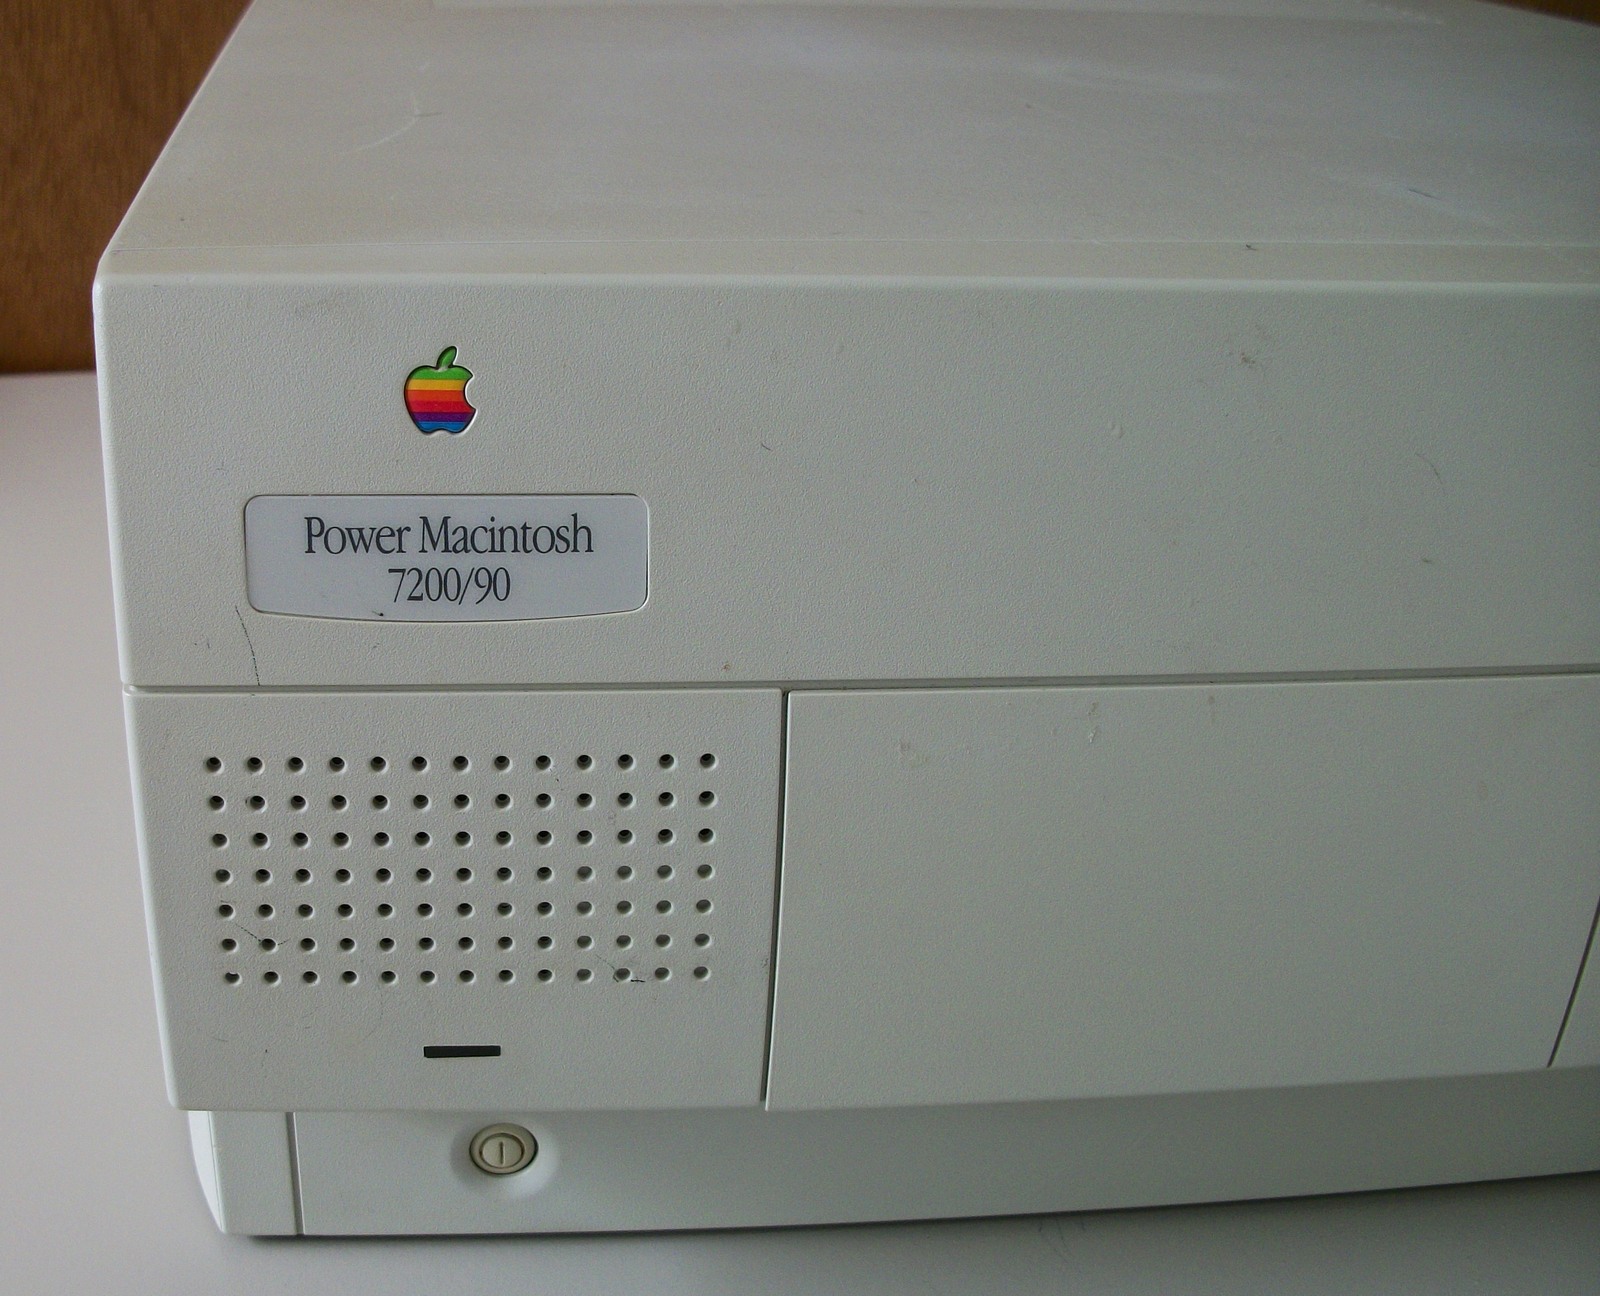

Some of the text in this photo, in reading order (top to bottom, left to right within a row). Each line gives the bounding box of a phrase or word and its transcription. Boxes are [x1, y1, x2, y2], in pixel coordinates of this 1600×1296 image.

[304, 512, 595, 555] Power Macintosh
[388, 566, 512, 605] 7200/90
